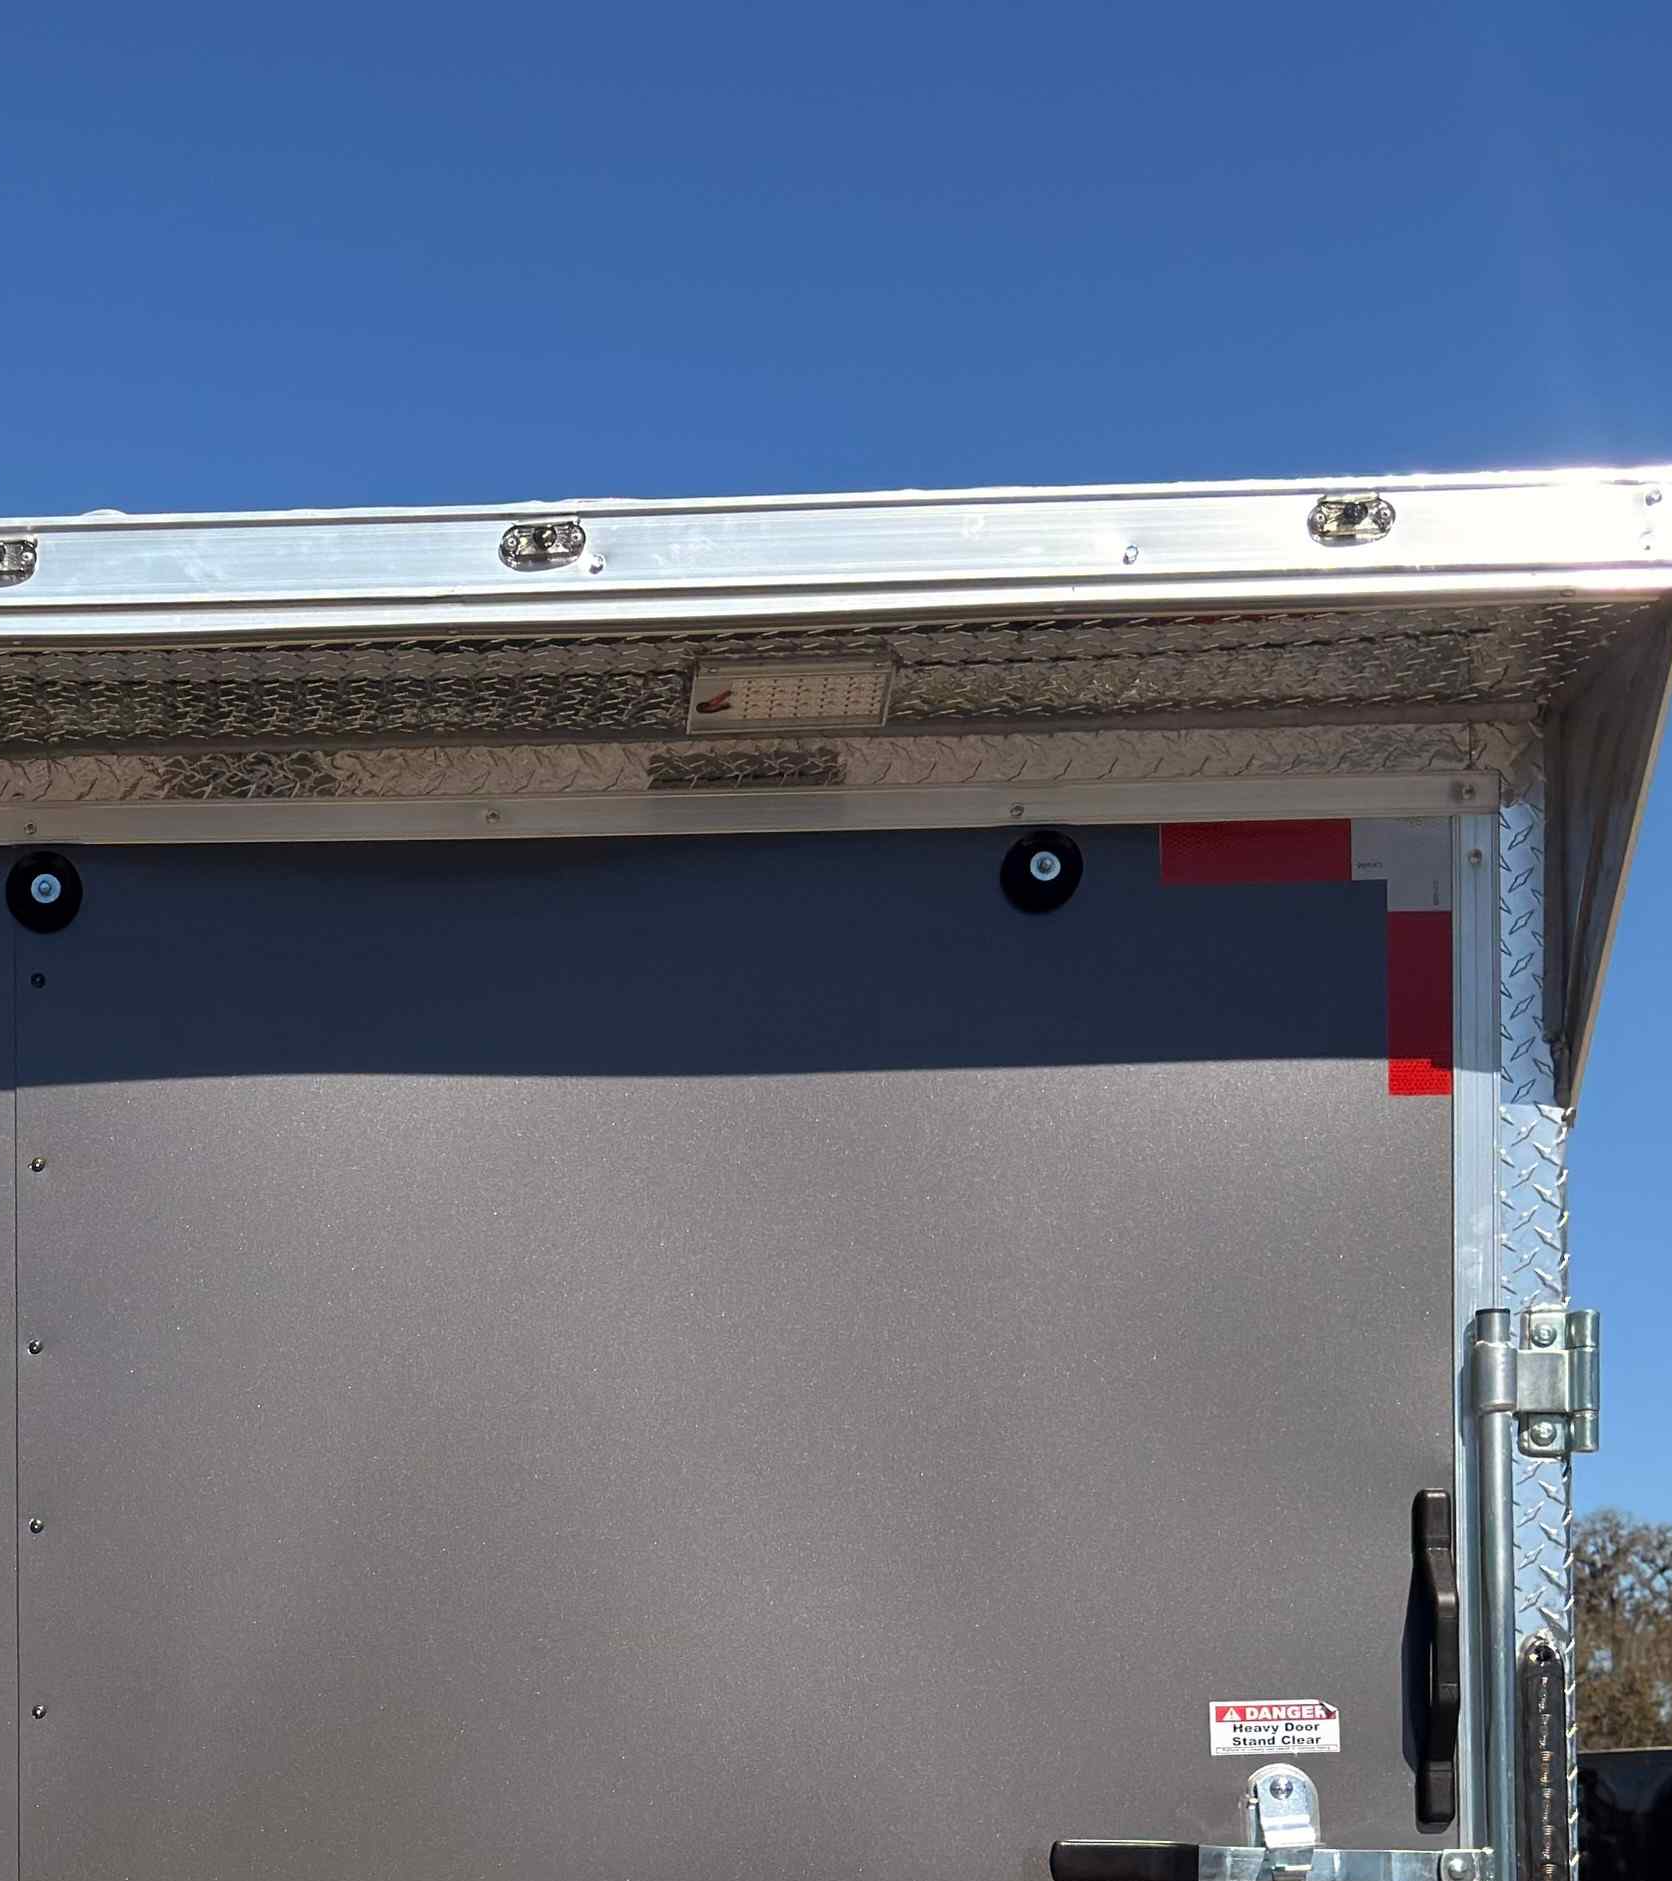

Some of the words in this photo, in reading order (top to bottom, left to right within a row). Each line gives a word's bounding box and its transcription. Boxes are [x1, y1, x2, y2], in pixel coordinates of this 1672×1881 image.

[1245, 1705, 1328, 1720] DANGER
[1233, 1723, 1279, 1734] Heavy
[1285, 1722, 1320, 1732] Door
[1232, 1736, 1276, 1746] Stand
[1281, 1735, 1321, 1745] Clear
